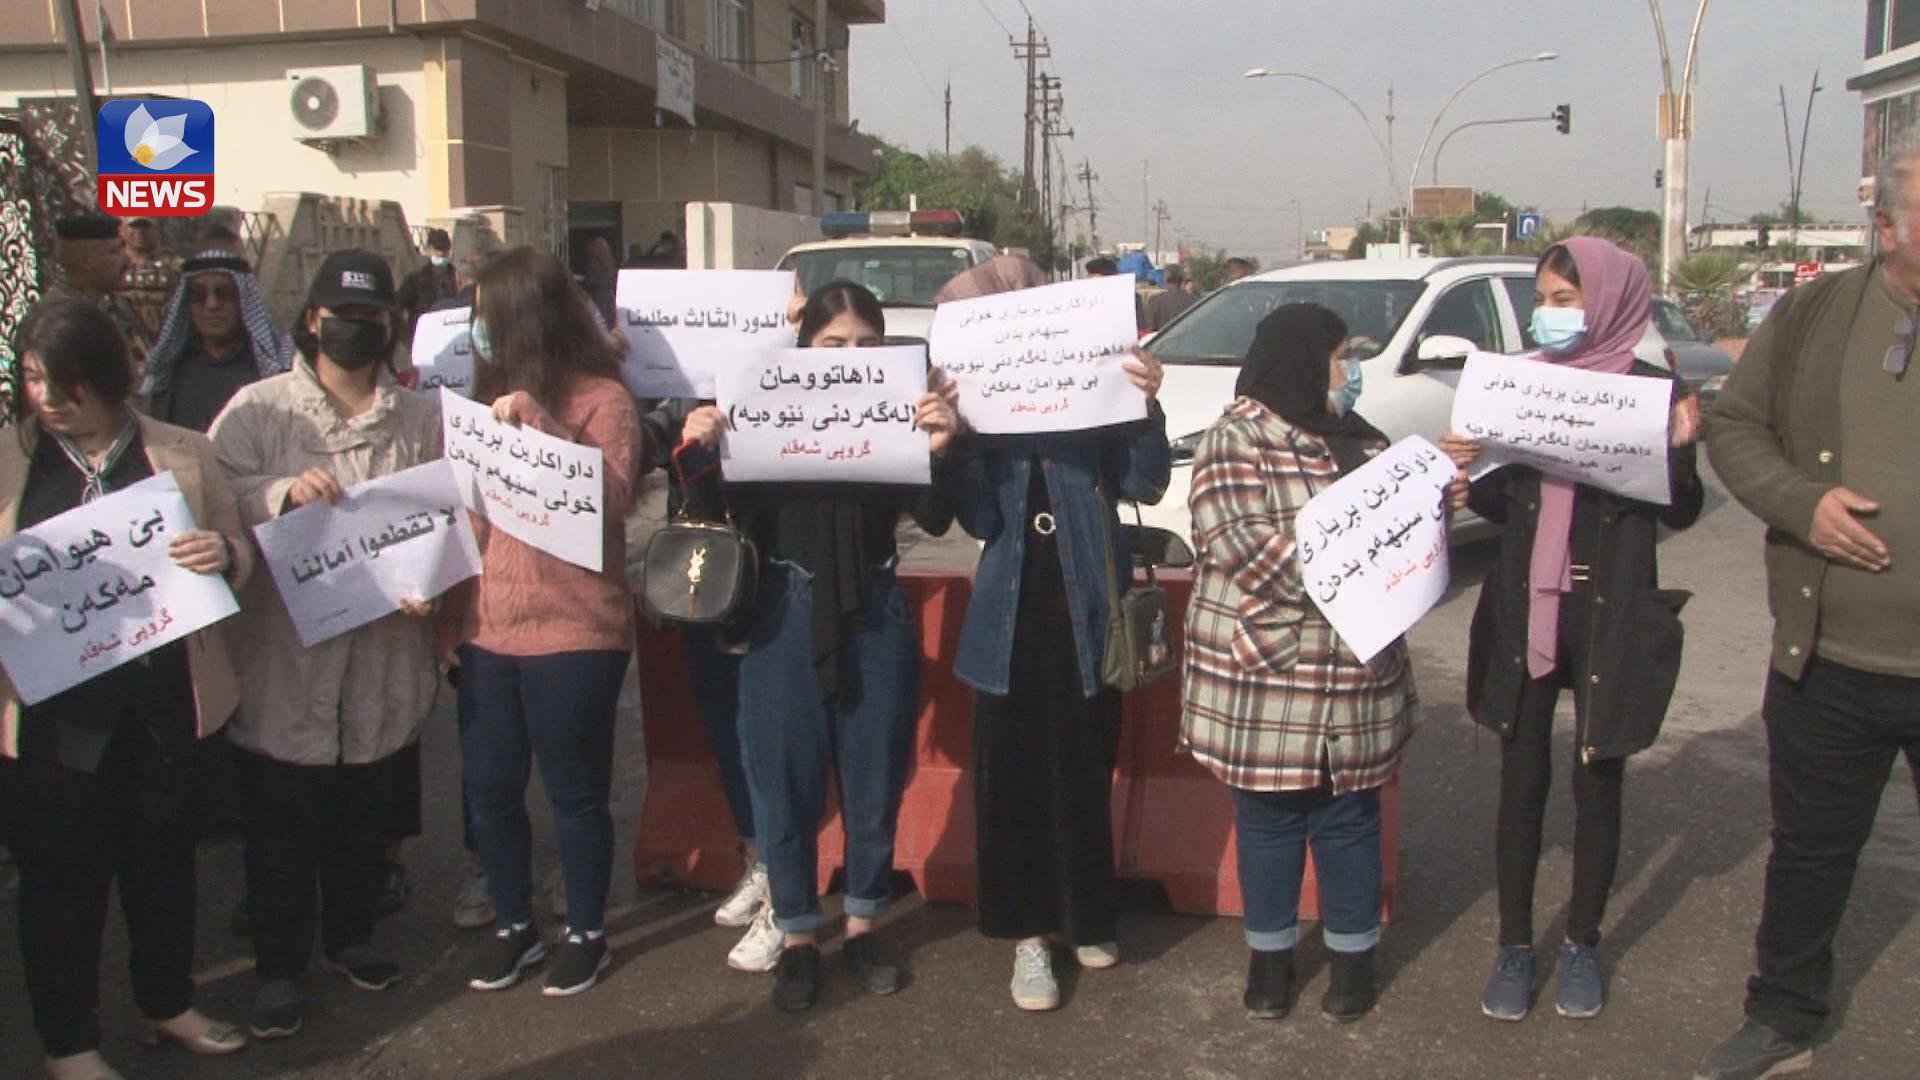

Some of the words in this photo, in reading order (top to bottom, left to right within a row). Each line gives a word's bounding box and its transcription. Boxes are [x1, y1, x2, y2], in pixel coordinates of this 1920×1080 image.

[626, 309, 679, 333] مطلبنا
[683, 306, 737, 329] الثالث
[741, 311, 785, 334] الدور
[760, 365, 885, 390] داهاتوومان
[509, 437, 595, 481] داواکارین
[543, 489, 599, 516] خولی
[439, 506, 458, 527] لا
[359, 510, 436, 560] تقطعوا
[290, 537, 354, 585] آمالنا
[62, 573, 156, 634] مەکەن
